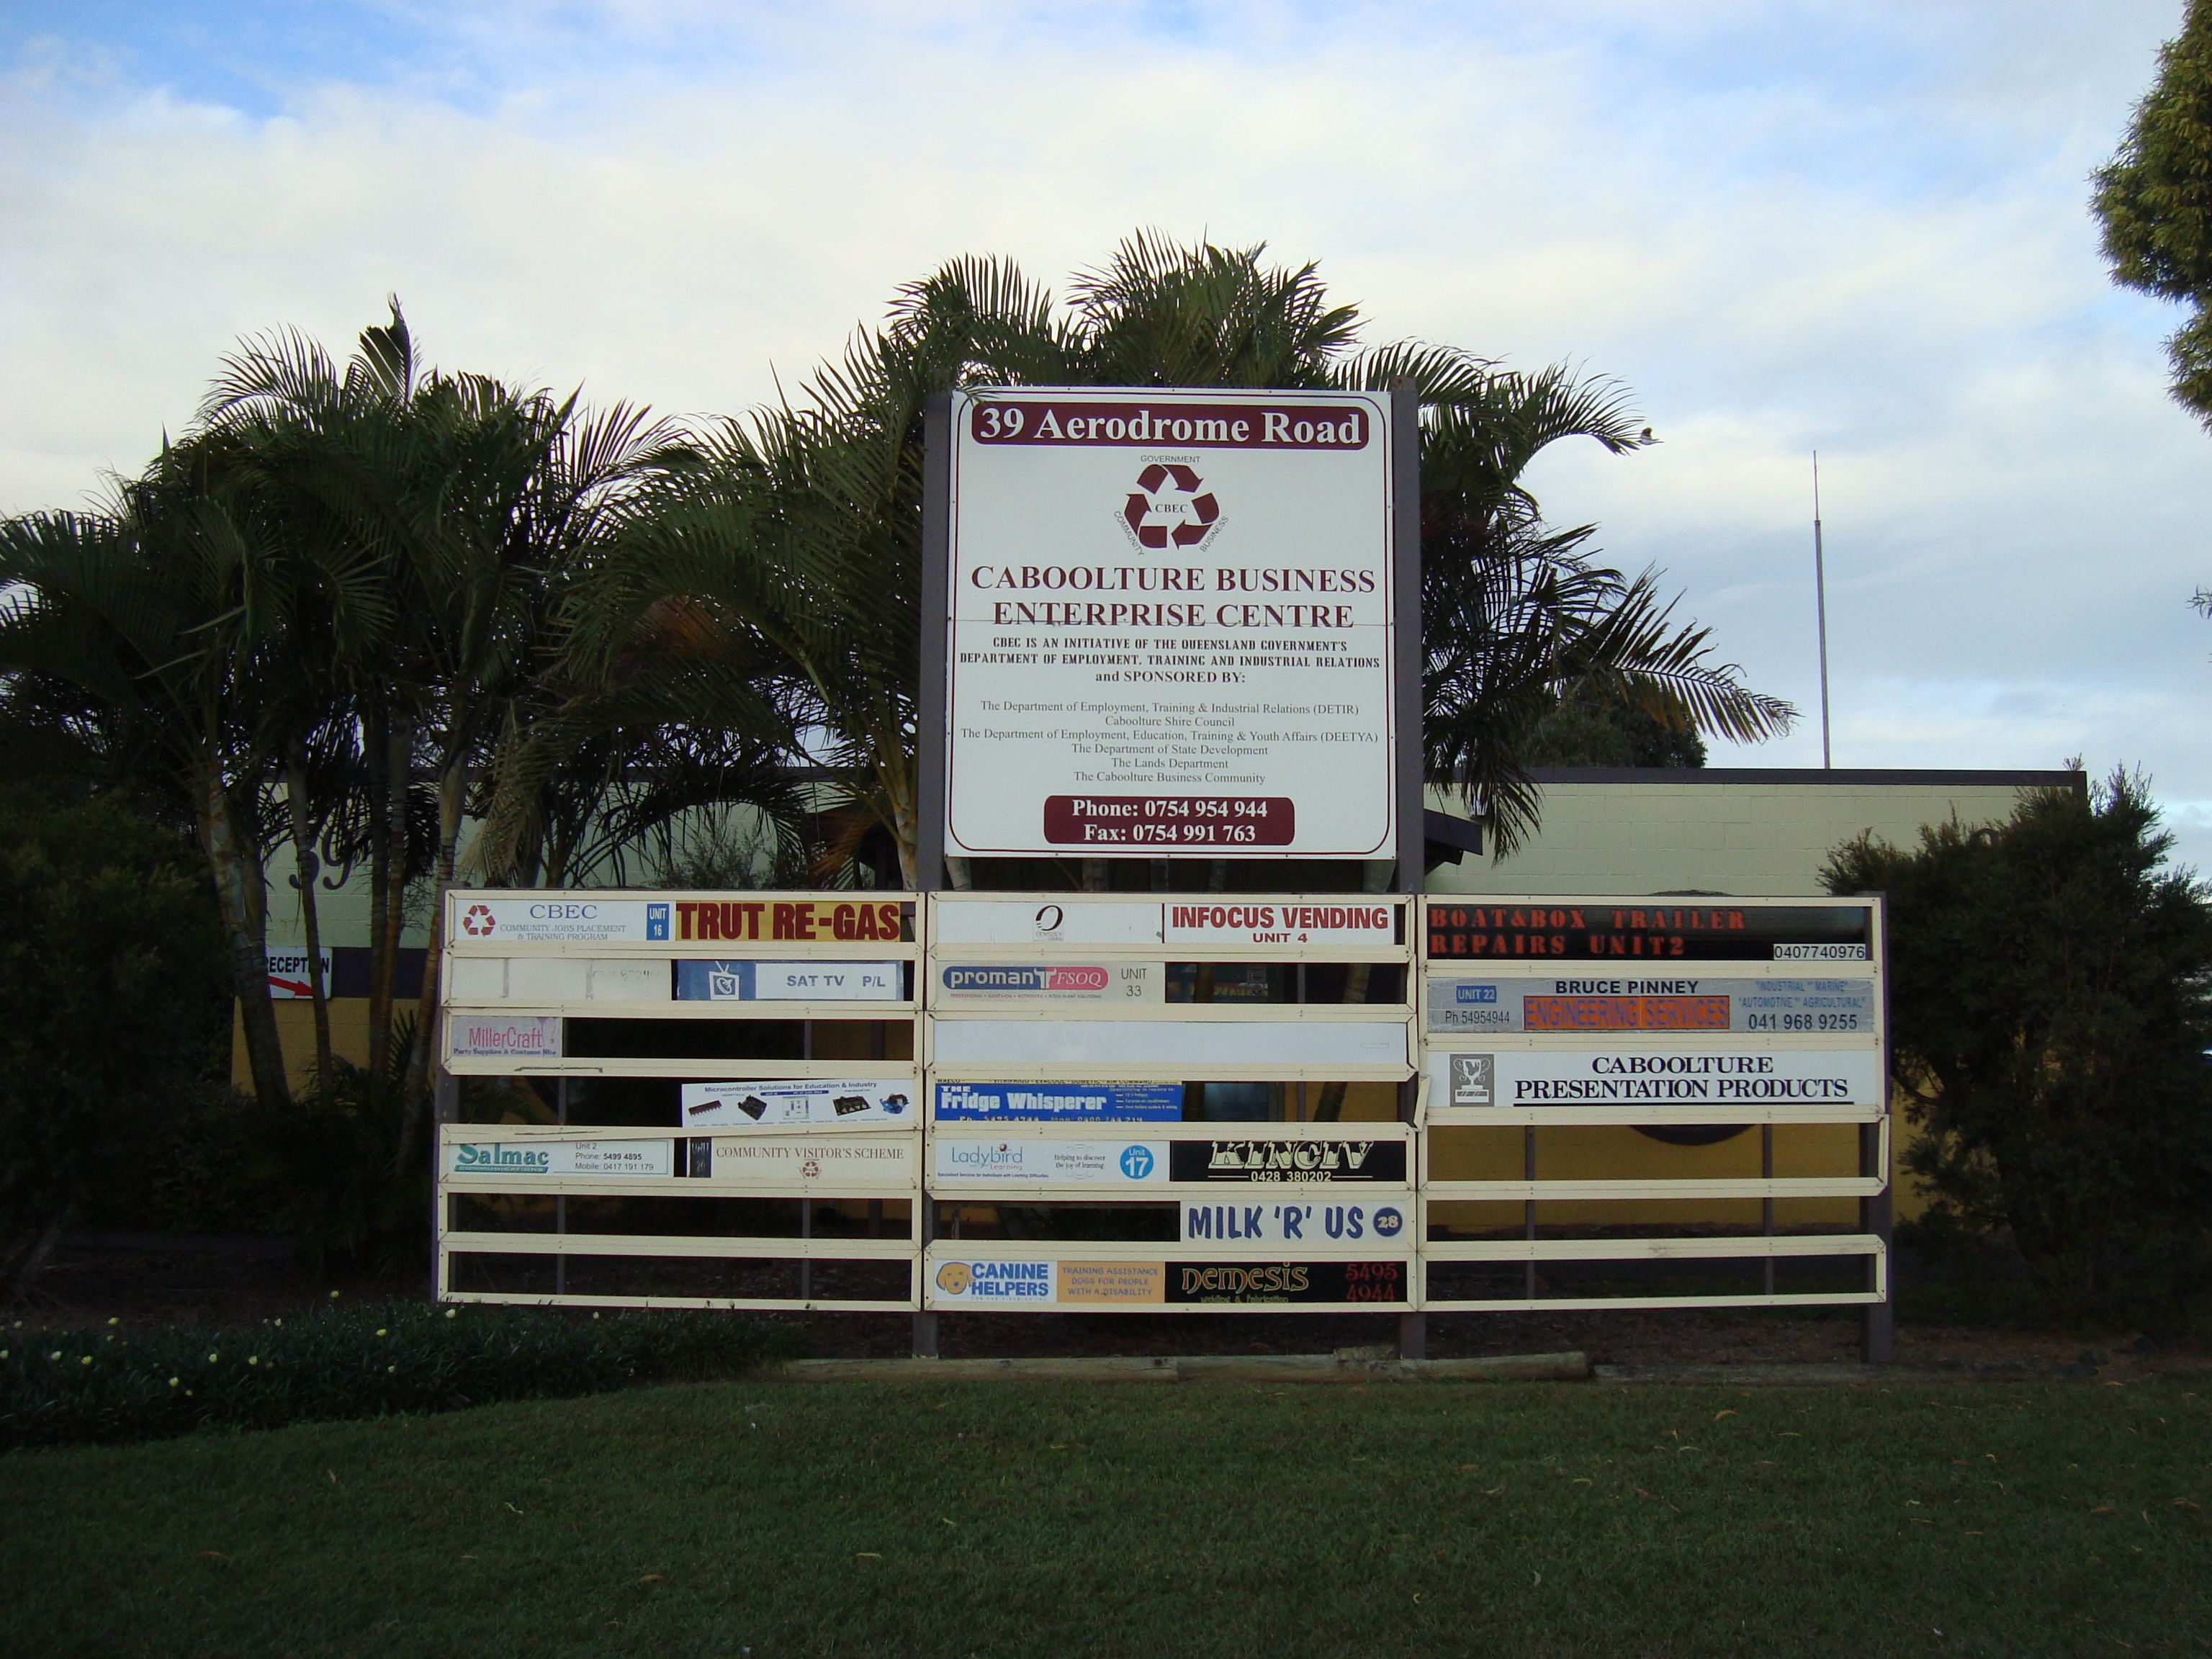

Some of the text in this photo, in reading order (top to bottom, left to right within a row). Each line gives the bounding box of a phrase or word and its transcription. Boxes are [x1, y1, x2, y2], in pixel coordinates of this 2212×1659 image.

[979, 407, 1362, 444] 39 Aerodrome Road
[1140, 454, 1201, 464] GOVERNMENT
[1155, 503, 1188, 513] CBEC
[1113, 511, 1145, 557] COMMUNITY
[1199, 516, 1229, 553] BUSINESS
[971, 566, 1375, 592] CABOOLTURE BUSINESS
[994, 602, 1354, 628] ENTERPRISE CENTRE
[993, 637, 1346, 651] CBEC IS AN INITIATIVE OF THE QUEENSLAND GOVERNMENT'S
[960, 652, 1038, 663] DEPARTMENT
[1043, 653, 1057, 664] OF
[1146, 655, 1205, 665] TRAINING
[1210, 655, 1234, 666] AND
[1239, 655, 1310, 667] INDUSTRIAL
[1316, 657, 1380, 667] RELATIONS
[1095, 670, 1245, 683] and SPONSORED BY:
[980, 700, 1359, 716] The Department of Employment, Training & Industrial Relations (DETIR)
[1105, 715, 1234, 727] Caboolture Shire Council
[961, 727, 1378, 743] The Department of Employment, Education, Training & Youth Affairs (DEETYA)
[1071, 742, 1268, 757] The Department of State Development
[1110, 757, 1228, 770] The Lands Department
[1073, 770, 1266, 785] The Caboolture Business Community
[1071, 799, 1268, 817] Phone: 0754 954 944
[1083, 823, 1256, 842] Fax: 0754 991 763
[529, 904, 597, 919] CBEC
[649, 907, 666, 920] UNIT
[1172, 906, 1388, 929] INFOCUS VENDING
[1430, 908, 1745, 930] BOAT&BOX TRAILER
[499, 923, 626, 933] COMMUNITY JOBS PLACEMENT
[675, 902, 902, 942] TRUT RE-GAS
[653, 924, 662, 937] 16
[1252, 932, 1308, 943] UNIT 4
[1429, 934, 1565, 954] REPAIRS
[1774, 945, 1866, 958] 0407740976
[786, 974, 886, 987] SAT TV P/L
[1056, 972, 1103, 989] FSOQ
[1120, 967, 1147, 980] UNIT
[1125, 984, 1142, 997] 33
[1457, 989, 1496, 1000] UNIT 22
[1555, 980, 1699, 994] BRUCE PINNEY
[1444, 1010, 1510, 1025] Ph 54954944
[1524, 998, 1729, 1028] ENGINEERING SERVICES
[1748, 1013, 1857, 1030] 041 968 9255
[468, 1027, 543, 1048] MillerCraft
[1591, 1056, 1773, 1074] CABOOLTURE
[1514, 1079, 1848, 1099] PRESENTATION PRODUCTS
[940, 1092, 1107, 1112] Fridge Whisperer
[457, 1144, 549, 1165] Salmac
[716, 1146, 904, 1161] COMMUNITY VISITOR'S SCHEME
[951, 1143, 1023, 1168] Ladybird
[989, 1162, 1022, 1171] Learning
[1125, 1159, 1144, 1177] 17
[1251, 1171, 1331, 1182] 0428 380202
[1188, 1205, 1364, 1239] MILK 'R' US
[1377, 1215, 1399, 1229] 28
[971, 1262, 1048, 1281] CANINE
[1062, 1267, 1159, 1276] TRAINING ASSISTANCE
[1344, 1262, 1398, 1282] 5495
[971, 1280, 1048, 1296] HELPERS
[1071, 1277, 1095, 1285] DOGS
[1102, 1287, 1153, 1296] DISABILITY
[1346, 1283, 1395, 1302] 4944
